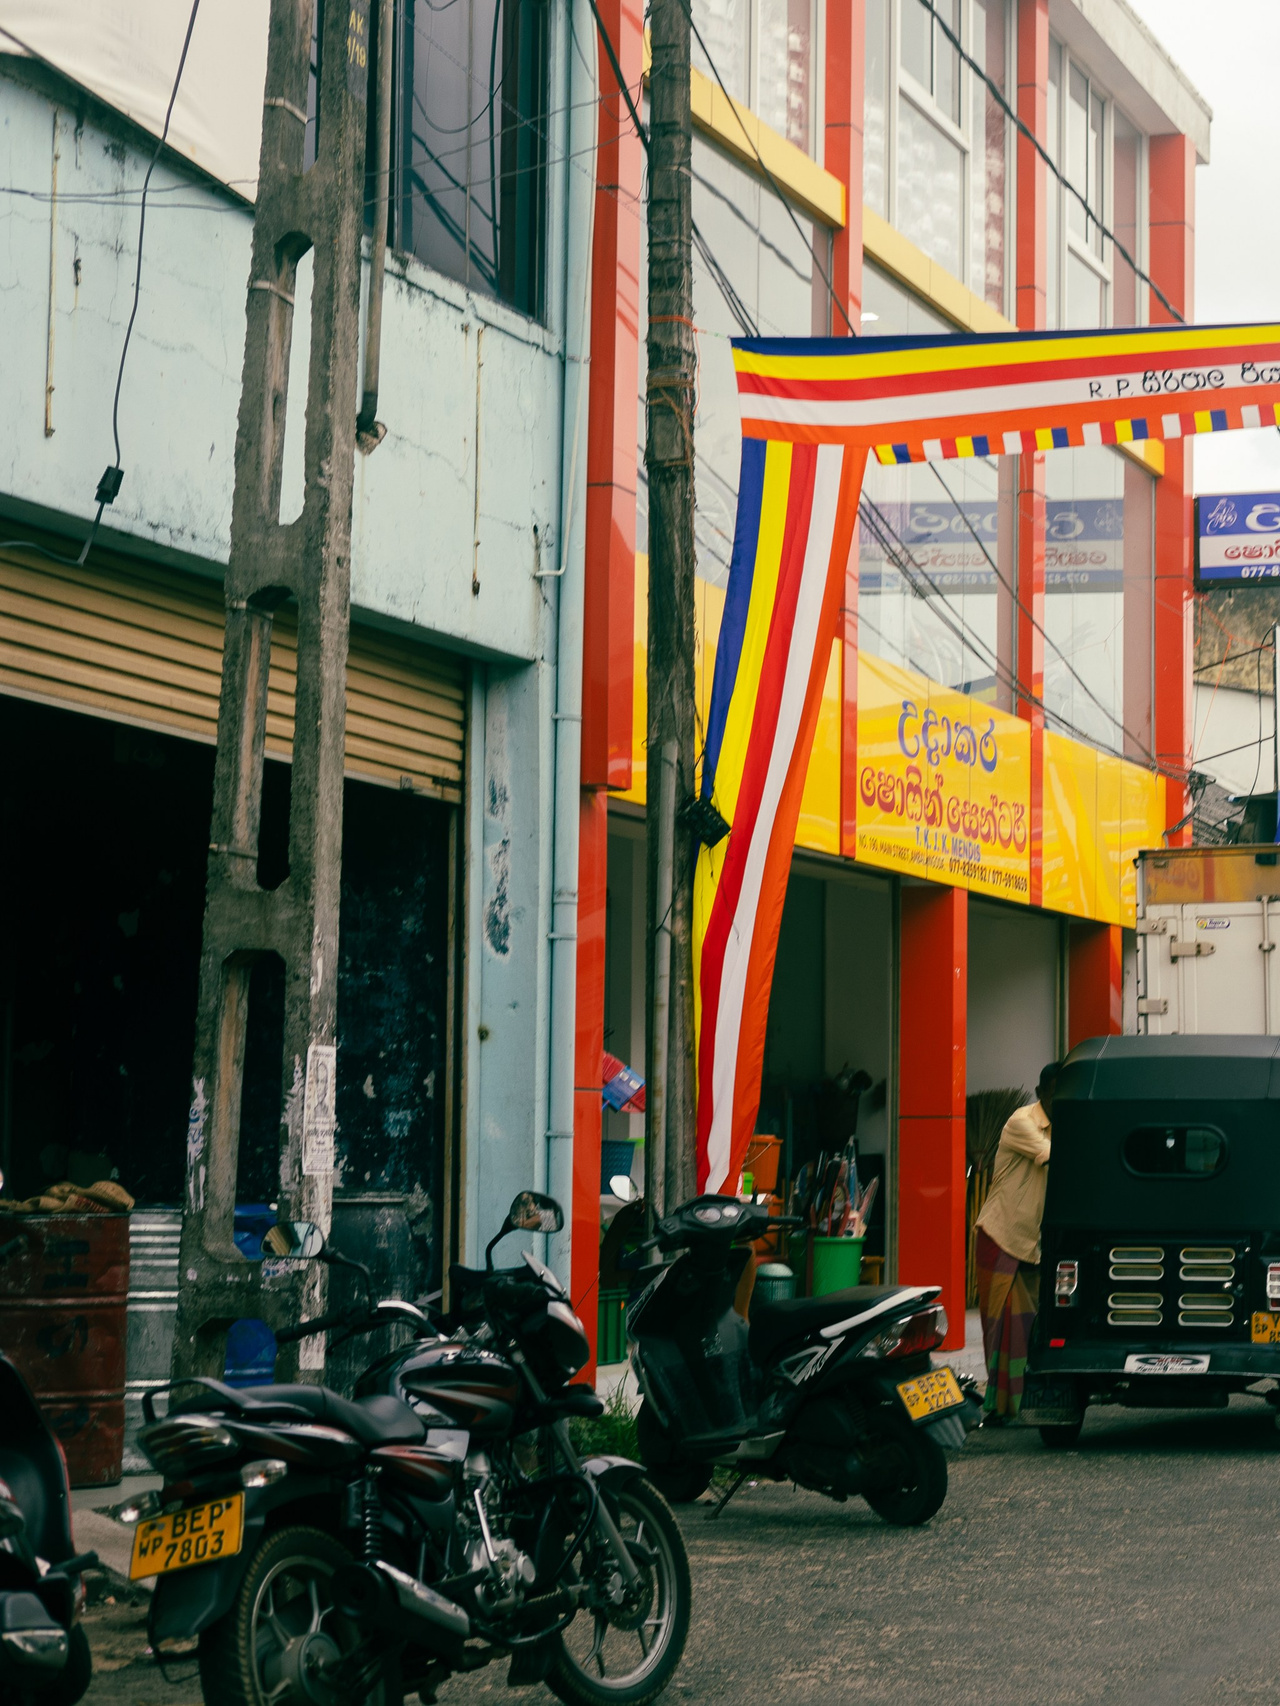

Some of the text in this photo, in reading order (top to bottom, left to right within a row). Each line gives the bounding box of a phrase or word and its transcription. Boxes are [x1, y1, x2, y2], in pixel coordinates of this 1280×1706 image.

[951, 836, 981, 863] MENDIS
[171, 1502, 225, 1539] BEP
[138, 1536, 163, 1559] WP
[164, 1530, 225, 1569] 7803
